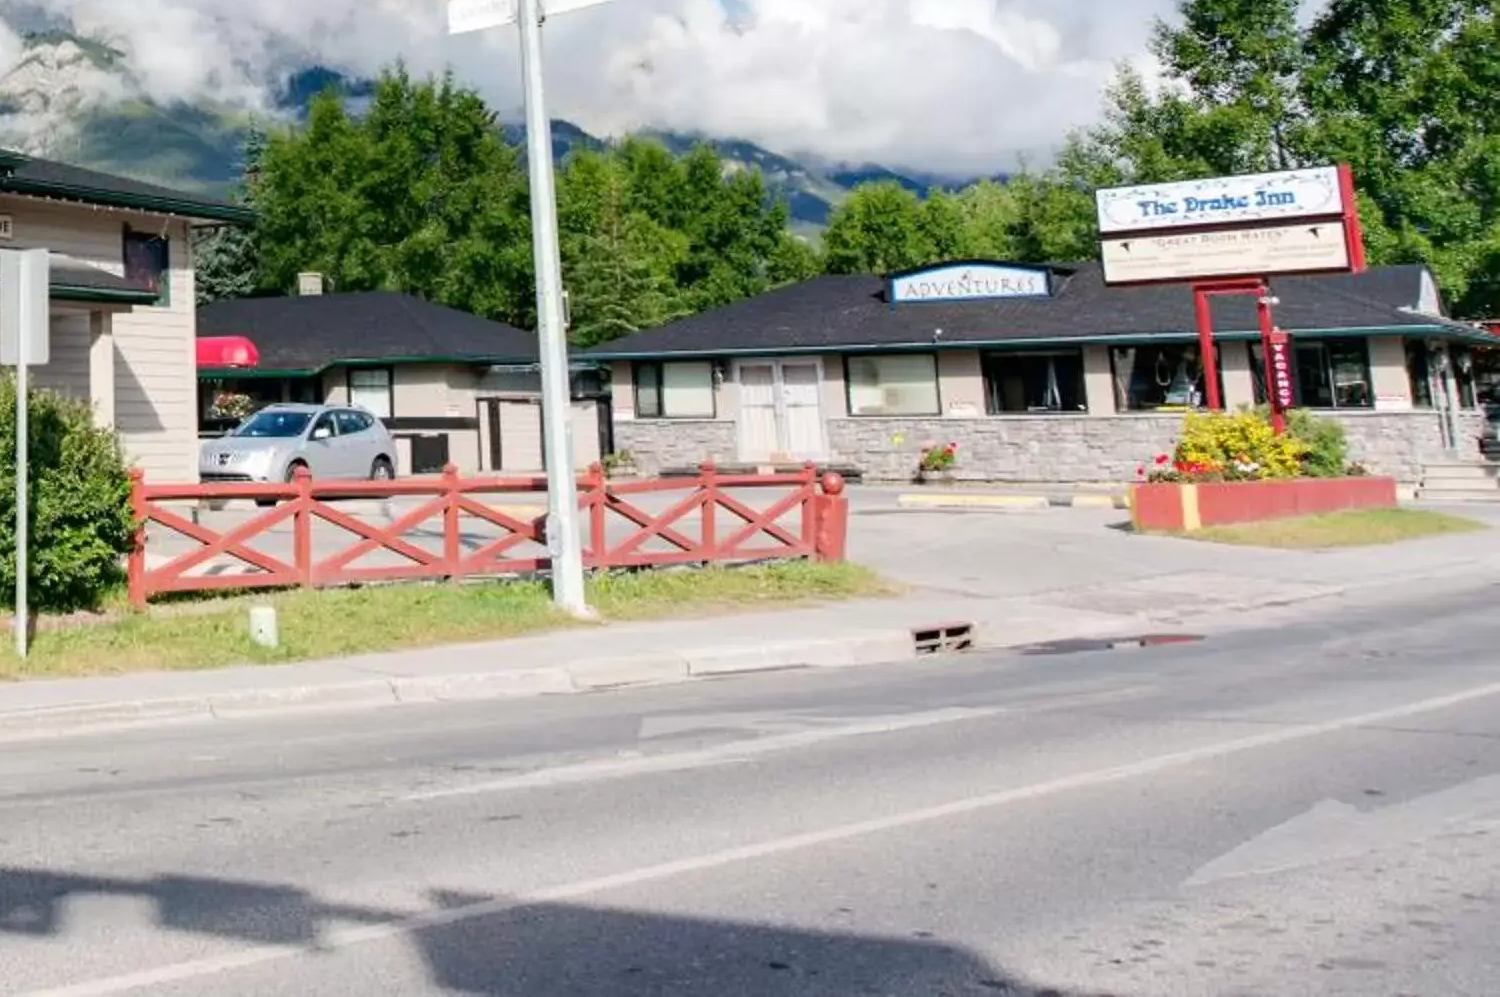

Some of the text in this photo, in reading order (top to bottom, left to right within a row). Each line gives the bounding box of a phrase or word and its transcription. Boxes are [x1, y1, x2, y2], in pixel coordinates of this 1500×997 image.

[1137, 189, 1296, 216] The Drake Inn
[904, 276, 1036, 298] ADVENTURES
[1272, 344, 1292, 406] VACANCY
